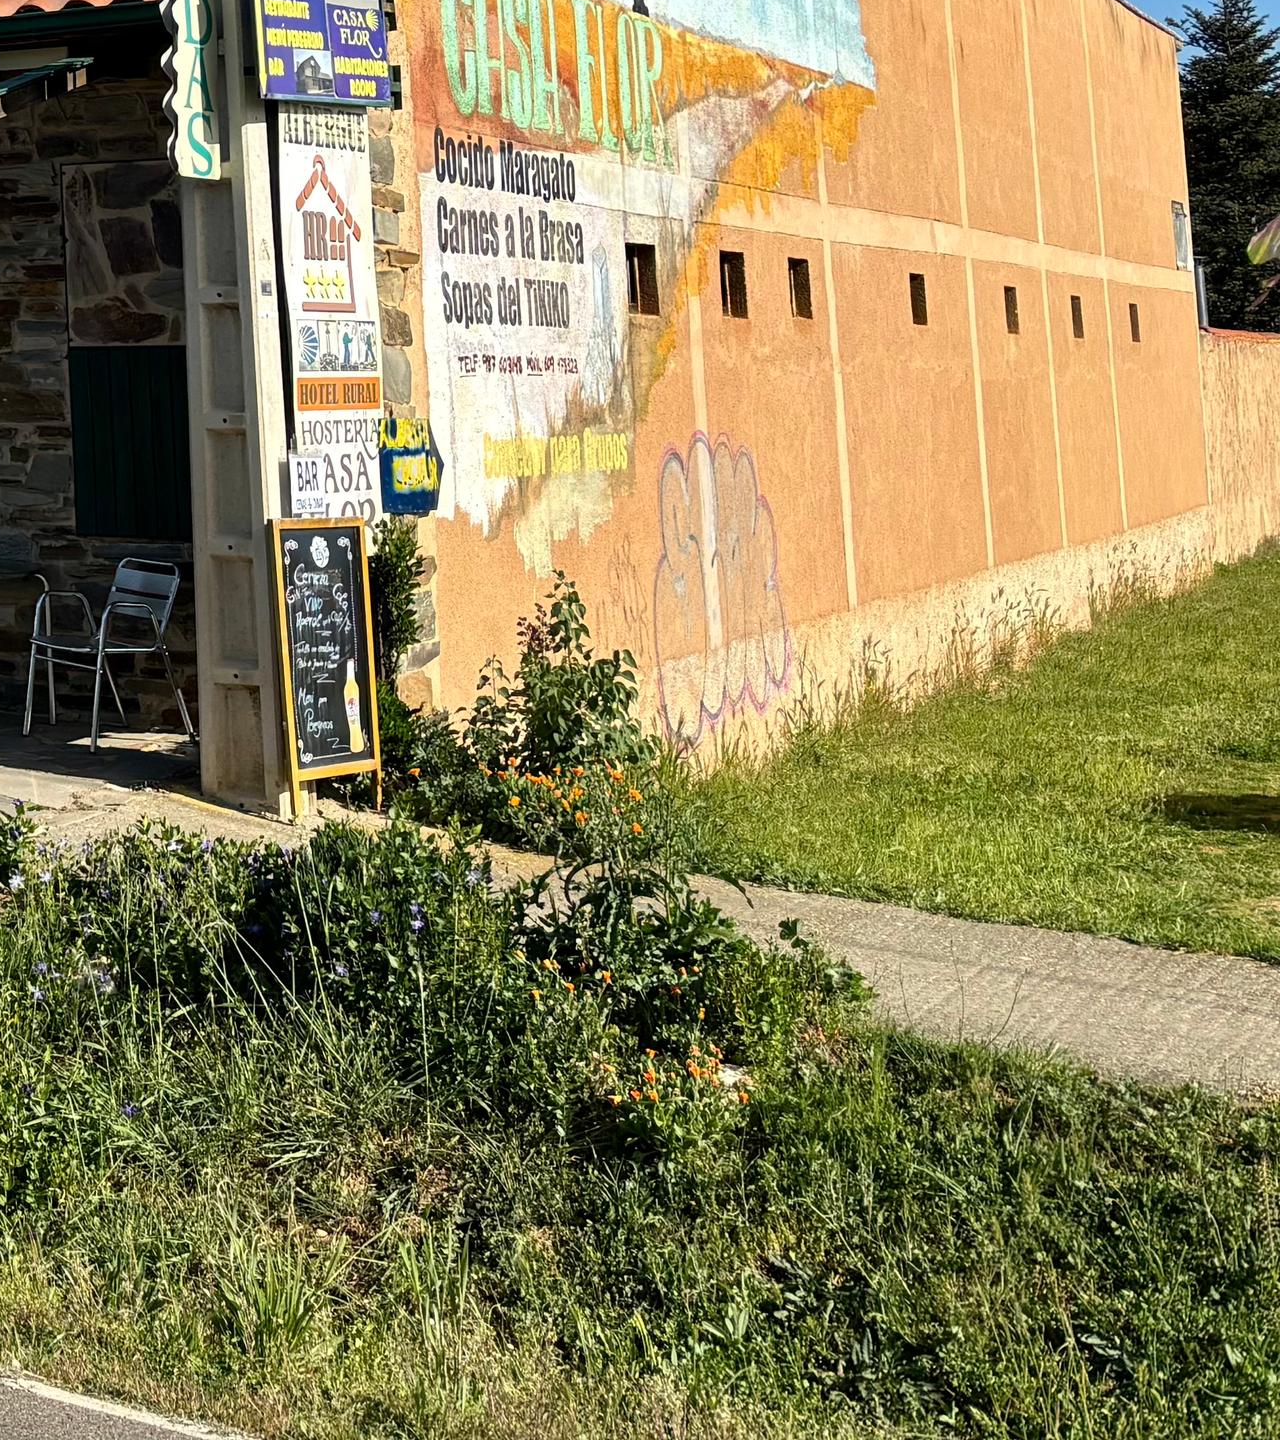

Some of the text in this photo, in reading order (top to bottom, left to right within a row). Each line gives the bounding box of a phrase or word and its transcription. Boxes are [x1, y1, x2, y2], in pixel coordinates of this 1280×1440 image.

[333, 9, 366, 28] CASA
[286, 29, 324, 50] PEREGRINO
[268, 57, 285, 76] BAR
[334, 56, 388, 78] HABITACIONES
[350, 78, 377, 97] ROOMS
[283, 104, 366, 153] ALBERGUE
[434, 127, 576, 203] Cocido Maragato
[437, 196, 585, 265] Carnes a la Brasa
[441, 271, 493, 329] Sopas
[497, 276, 522, 326] del
[299, 382, 379, 405] HOTEL RURAL
[297, 461, 319, 492] BAR
[323, 451, 373, 494] ASA
